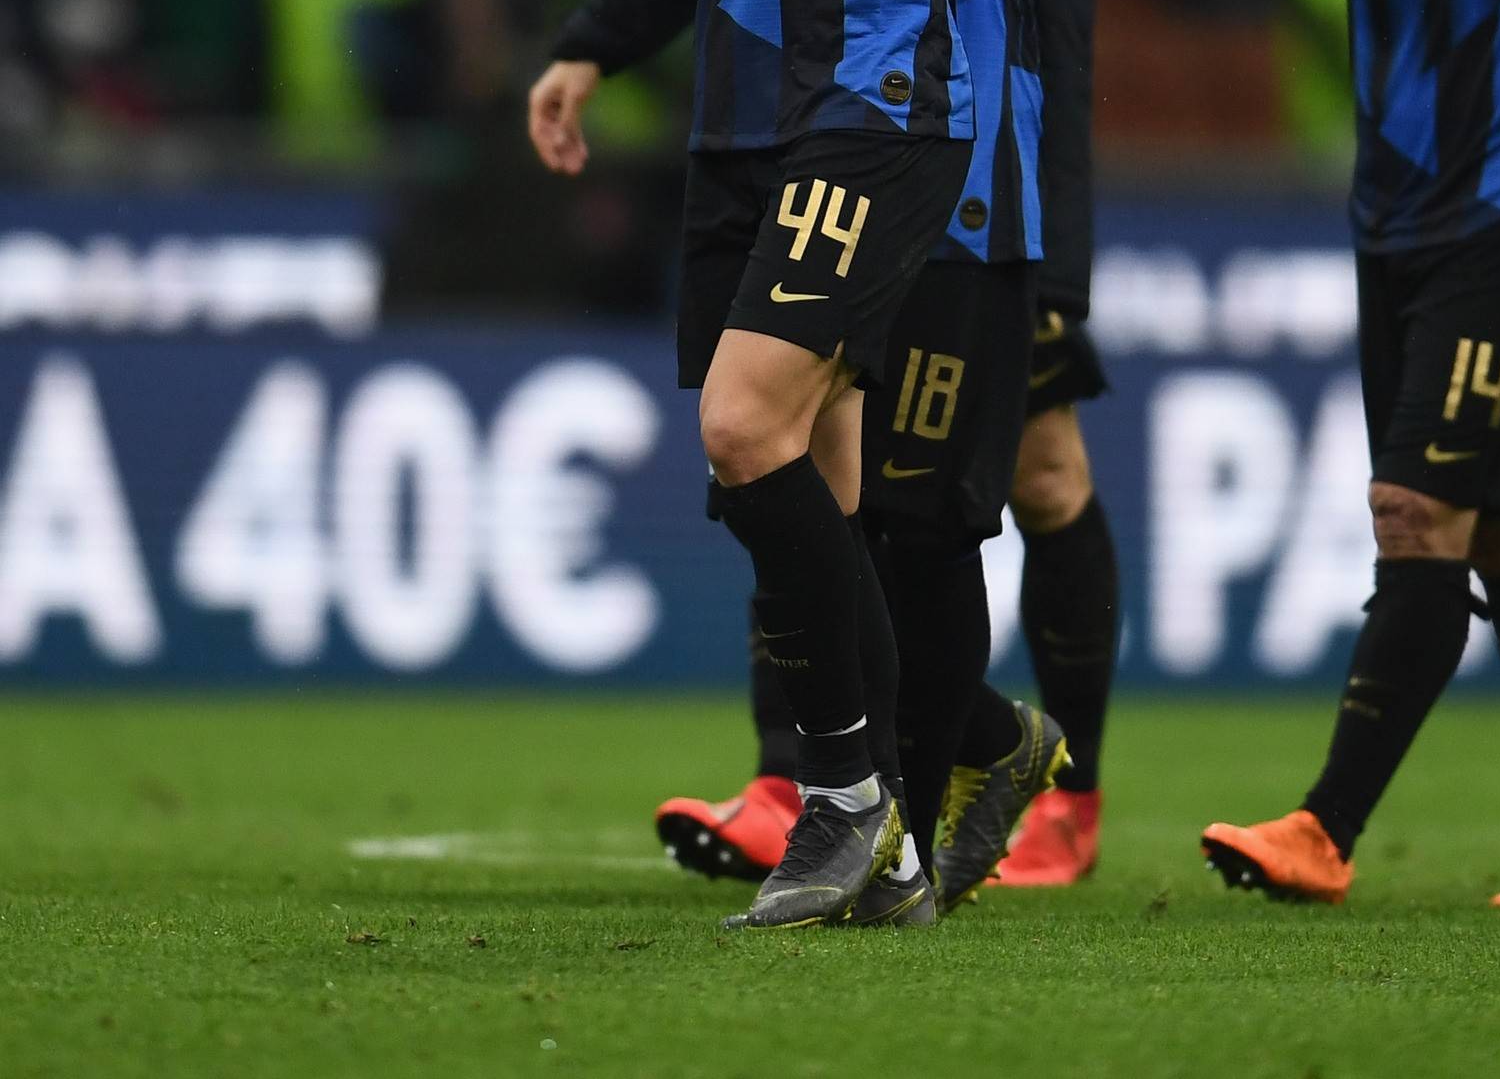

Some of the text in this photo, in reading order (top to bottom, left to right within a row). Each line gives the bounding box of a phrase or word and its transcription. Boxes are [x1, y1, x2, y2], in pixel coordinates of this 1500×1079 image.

[777, 178, 871, 278] 44
[893, 348, 965, 440] 18
[174, 355, 662, 674] 40€
